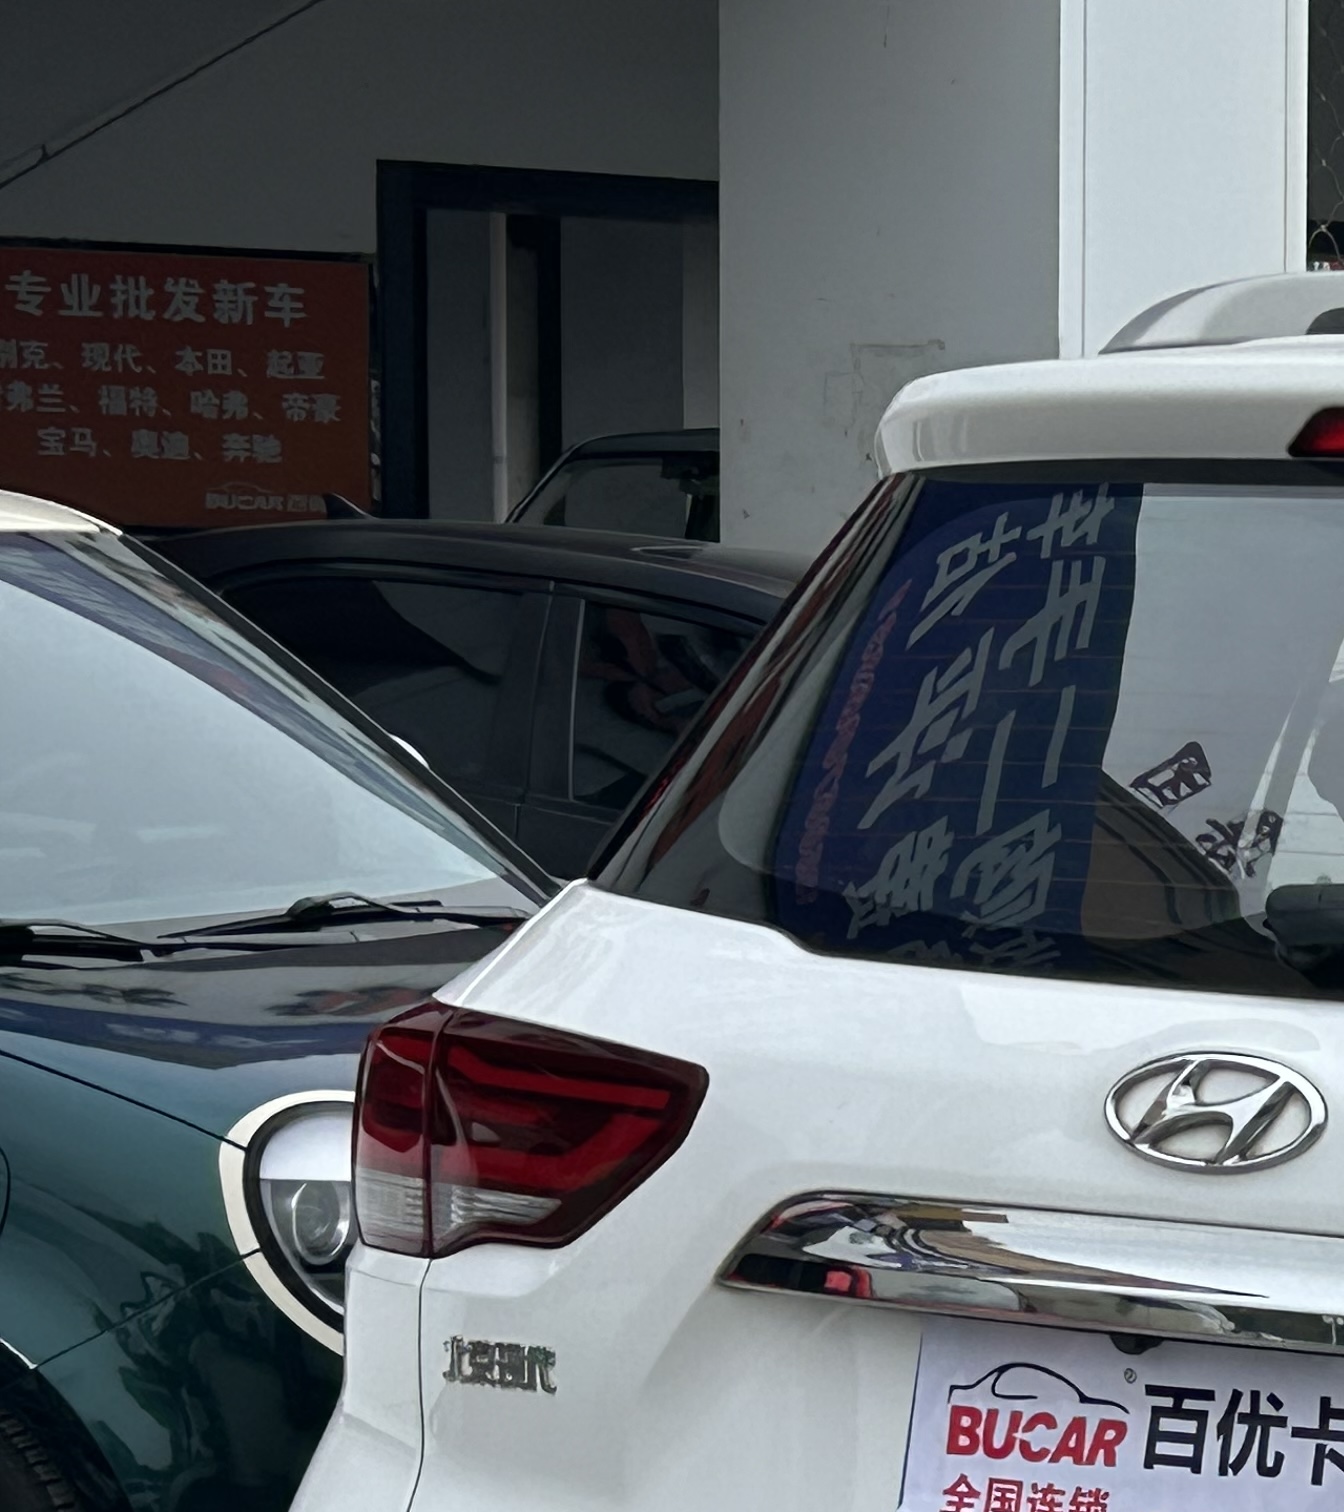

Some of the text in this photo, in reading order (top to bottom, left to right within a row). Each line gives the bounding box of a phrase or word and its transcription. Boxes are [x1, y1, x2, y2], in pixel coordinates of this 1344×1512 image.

[5, 270, 307, 327] 专业批发新车
[945, 1405, 1129, 1468] BUCAR
